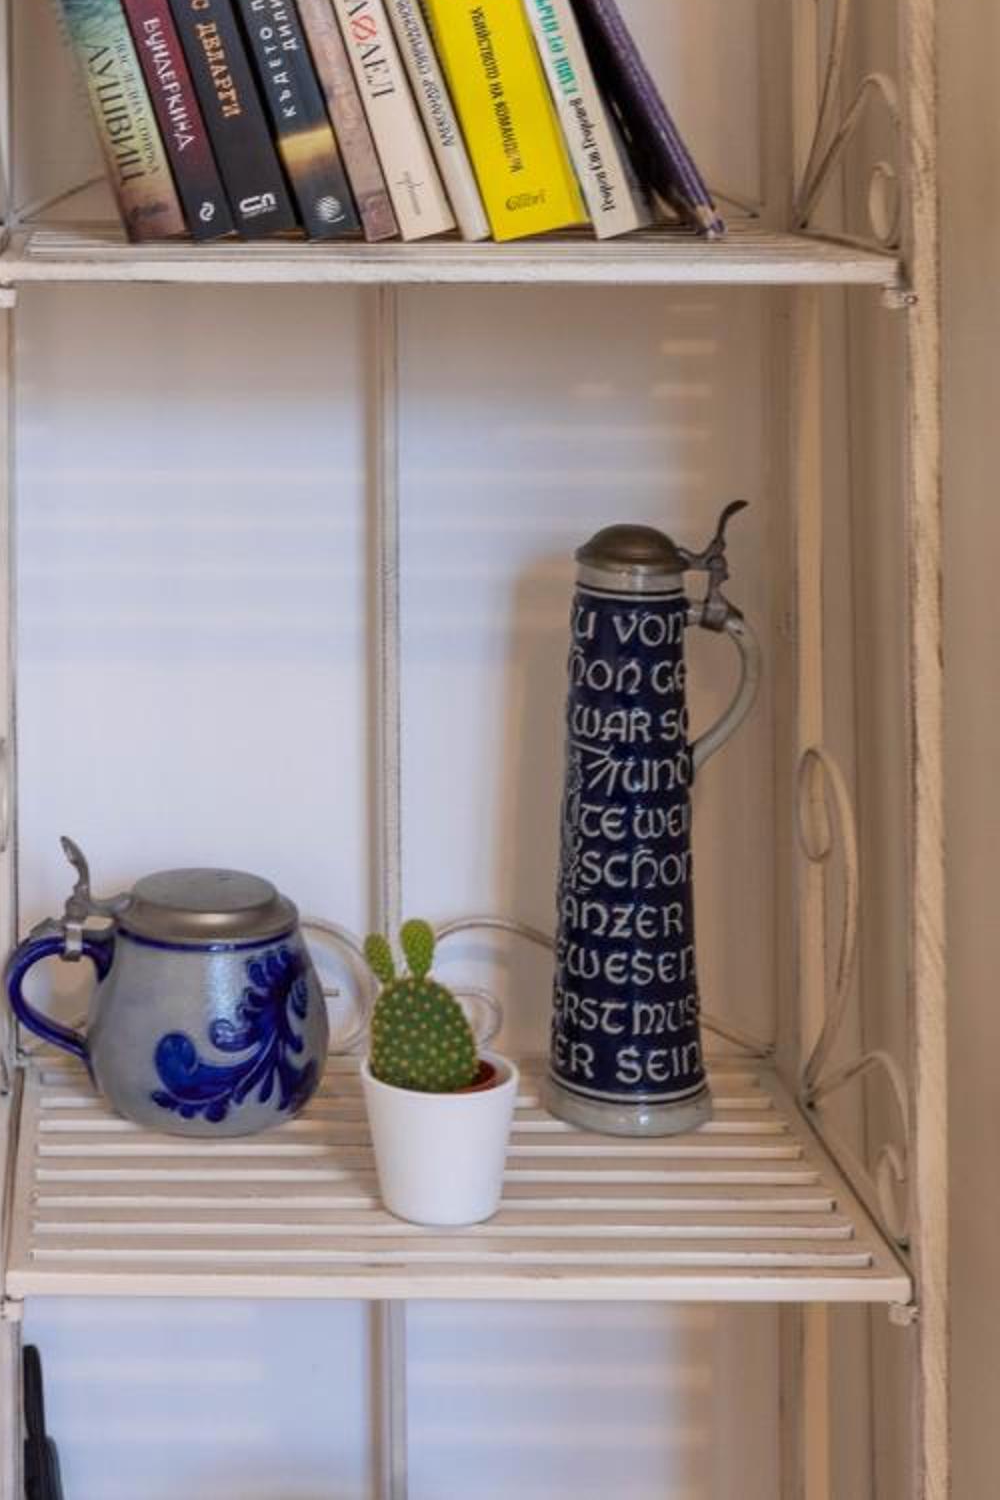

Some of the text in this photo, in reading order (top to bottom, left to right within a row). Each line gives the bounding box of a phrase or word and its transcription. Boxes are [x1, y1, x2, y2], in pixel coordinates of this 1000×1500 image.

[82, 39, 147, 187] АУШВИЦ
[140, 16, 197, 151] ВУНДЕРКИНД
[194, 20, 241, 119] ДЕЛАРГИ
[257, 25, 299, 118] КЪДЕТО
[487, 81, 504, 100] НА
[491, 101, 524, 173] КОМАНДА
[572, 704, 651, 743] WAR
